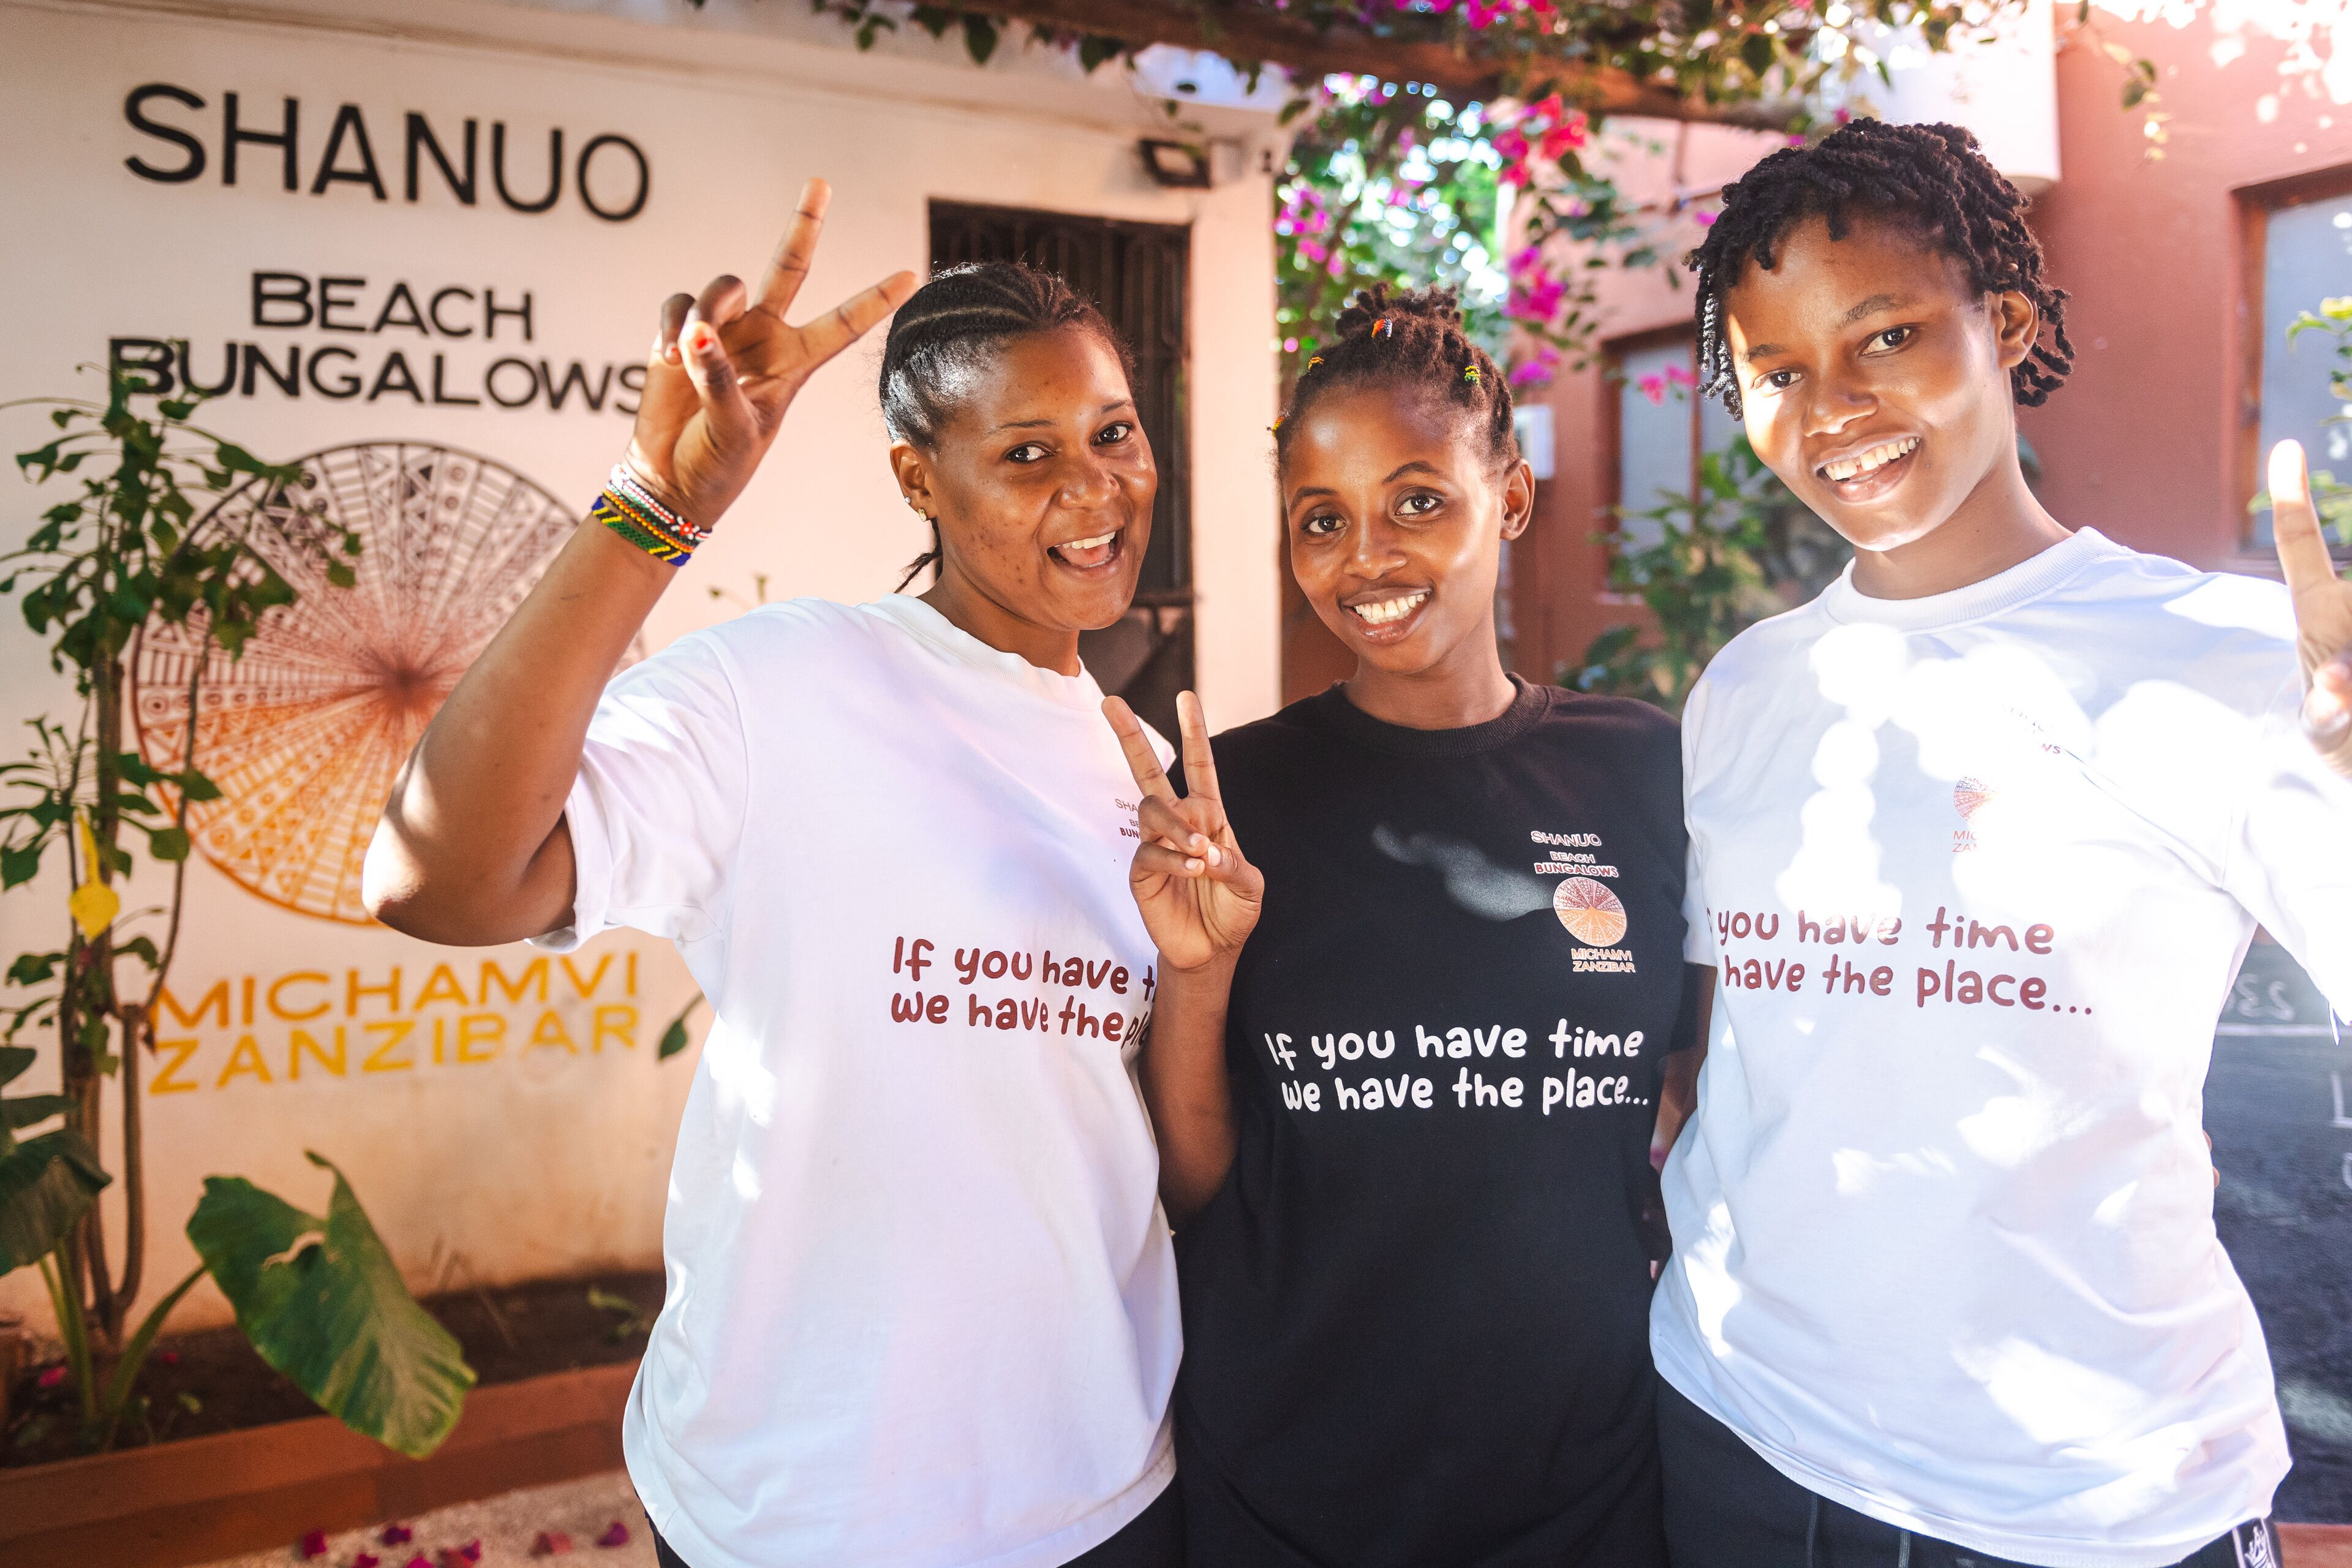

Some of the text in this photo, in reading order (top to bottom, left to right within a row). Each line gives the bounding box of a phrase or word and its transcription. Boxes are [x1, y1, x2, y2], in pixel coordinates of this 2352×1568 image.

[124, 83, 650, 223] SHANUO
[251, 271, 534, 342] BEACH
[109, 337, 646, 417] BUNGALOWS
[1115, 798, 1139, 812] SHA
[1531, 831, 1602, 847] SHANUO
[1550, 851, 1596, 864] BEACH
[1534, 862, 1619, 878] BUNGALOWS
[1571, 948, 1632, 961] MICHAMVI
[1717, 910, 1779, 946] you
[1798, 910, 1902, 945] have
[1926, 907, 2054, 954] time
[149, 951, 638, 1031] MICHAMVI
[893, 936, 935, 982] If
[954, 948, 1033, 985] you
[1042, 950, 1129, 995] have
[1572, 960, 1635, 973] ZANZIBAR
[1725, 954, 2092, 1014] have the place...
[891, 991, 949, 1024] we
[968, 993, 1049, 1032] have
[1059, 995, 1125, 1042] the
[149, 1003, 639, 1095] ZANZIBAR
[1264, 1018, 1645, 1071] If you have time
[1281, 1067, 1649, 1115] we have the place...
